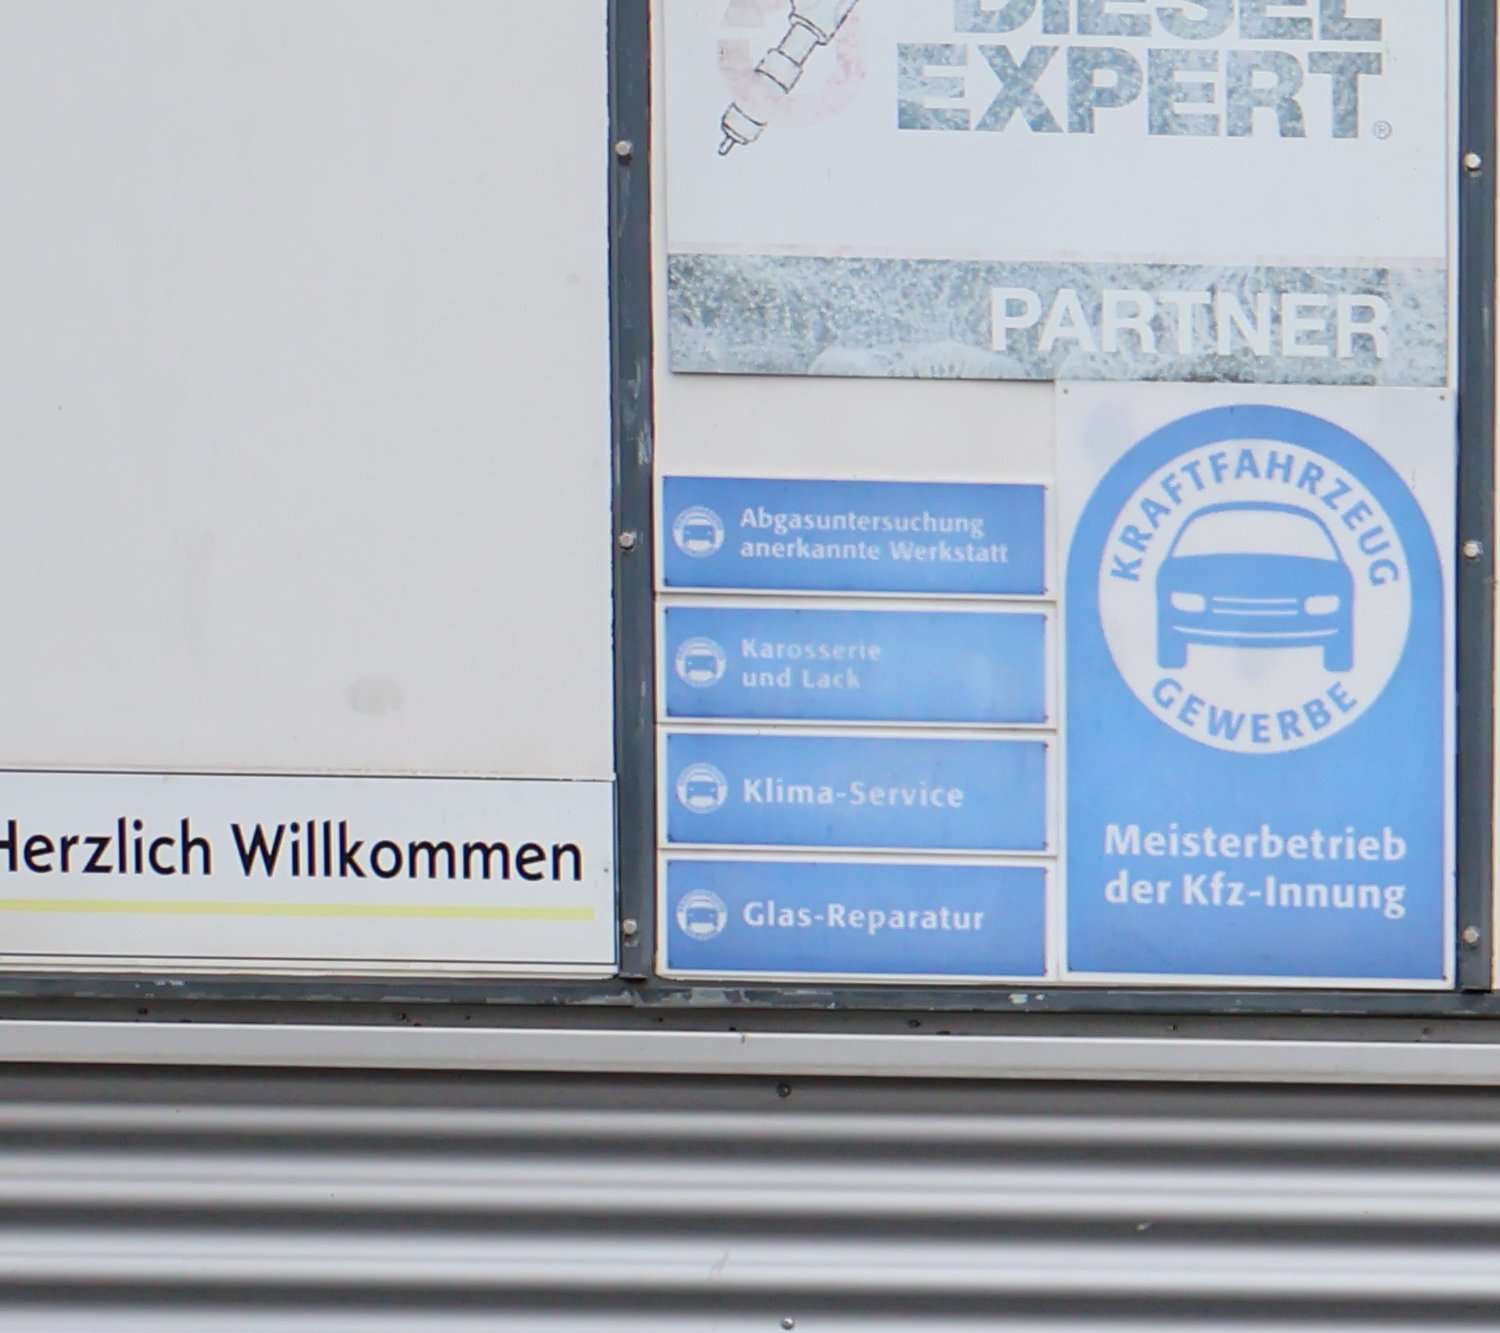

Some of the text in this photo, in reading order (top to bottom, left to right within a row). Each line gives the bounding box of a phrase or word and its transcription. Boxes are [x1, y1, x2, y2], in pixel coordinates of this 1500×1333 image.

[989, 286, 1391, 361] PARTNER
[740, 506, 985, 538] Abgasuntersuchung
[1108, 447, 1401, 590] KRAFTFAHRZEUG
[740, 536, 1009, 565] anerkannte Werkstatt
[742, 638, 882, 661] Karosserie
[743, 665, 862, 690] und Lack
[1151, 675, 1360, 746] GEWERBE
[743, 778, 965, 810] Klima-Service
[230, 819, 583, 882] Willkommen
[1104, 822, 1408, 863] Meisterbetrieb
[1104, 870, 1406, 920] der Kfz-Innung
[743, 900, 985, 935] Glas-Reparatur
